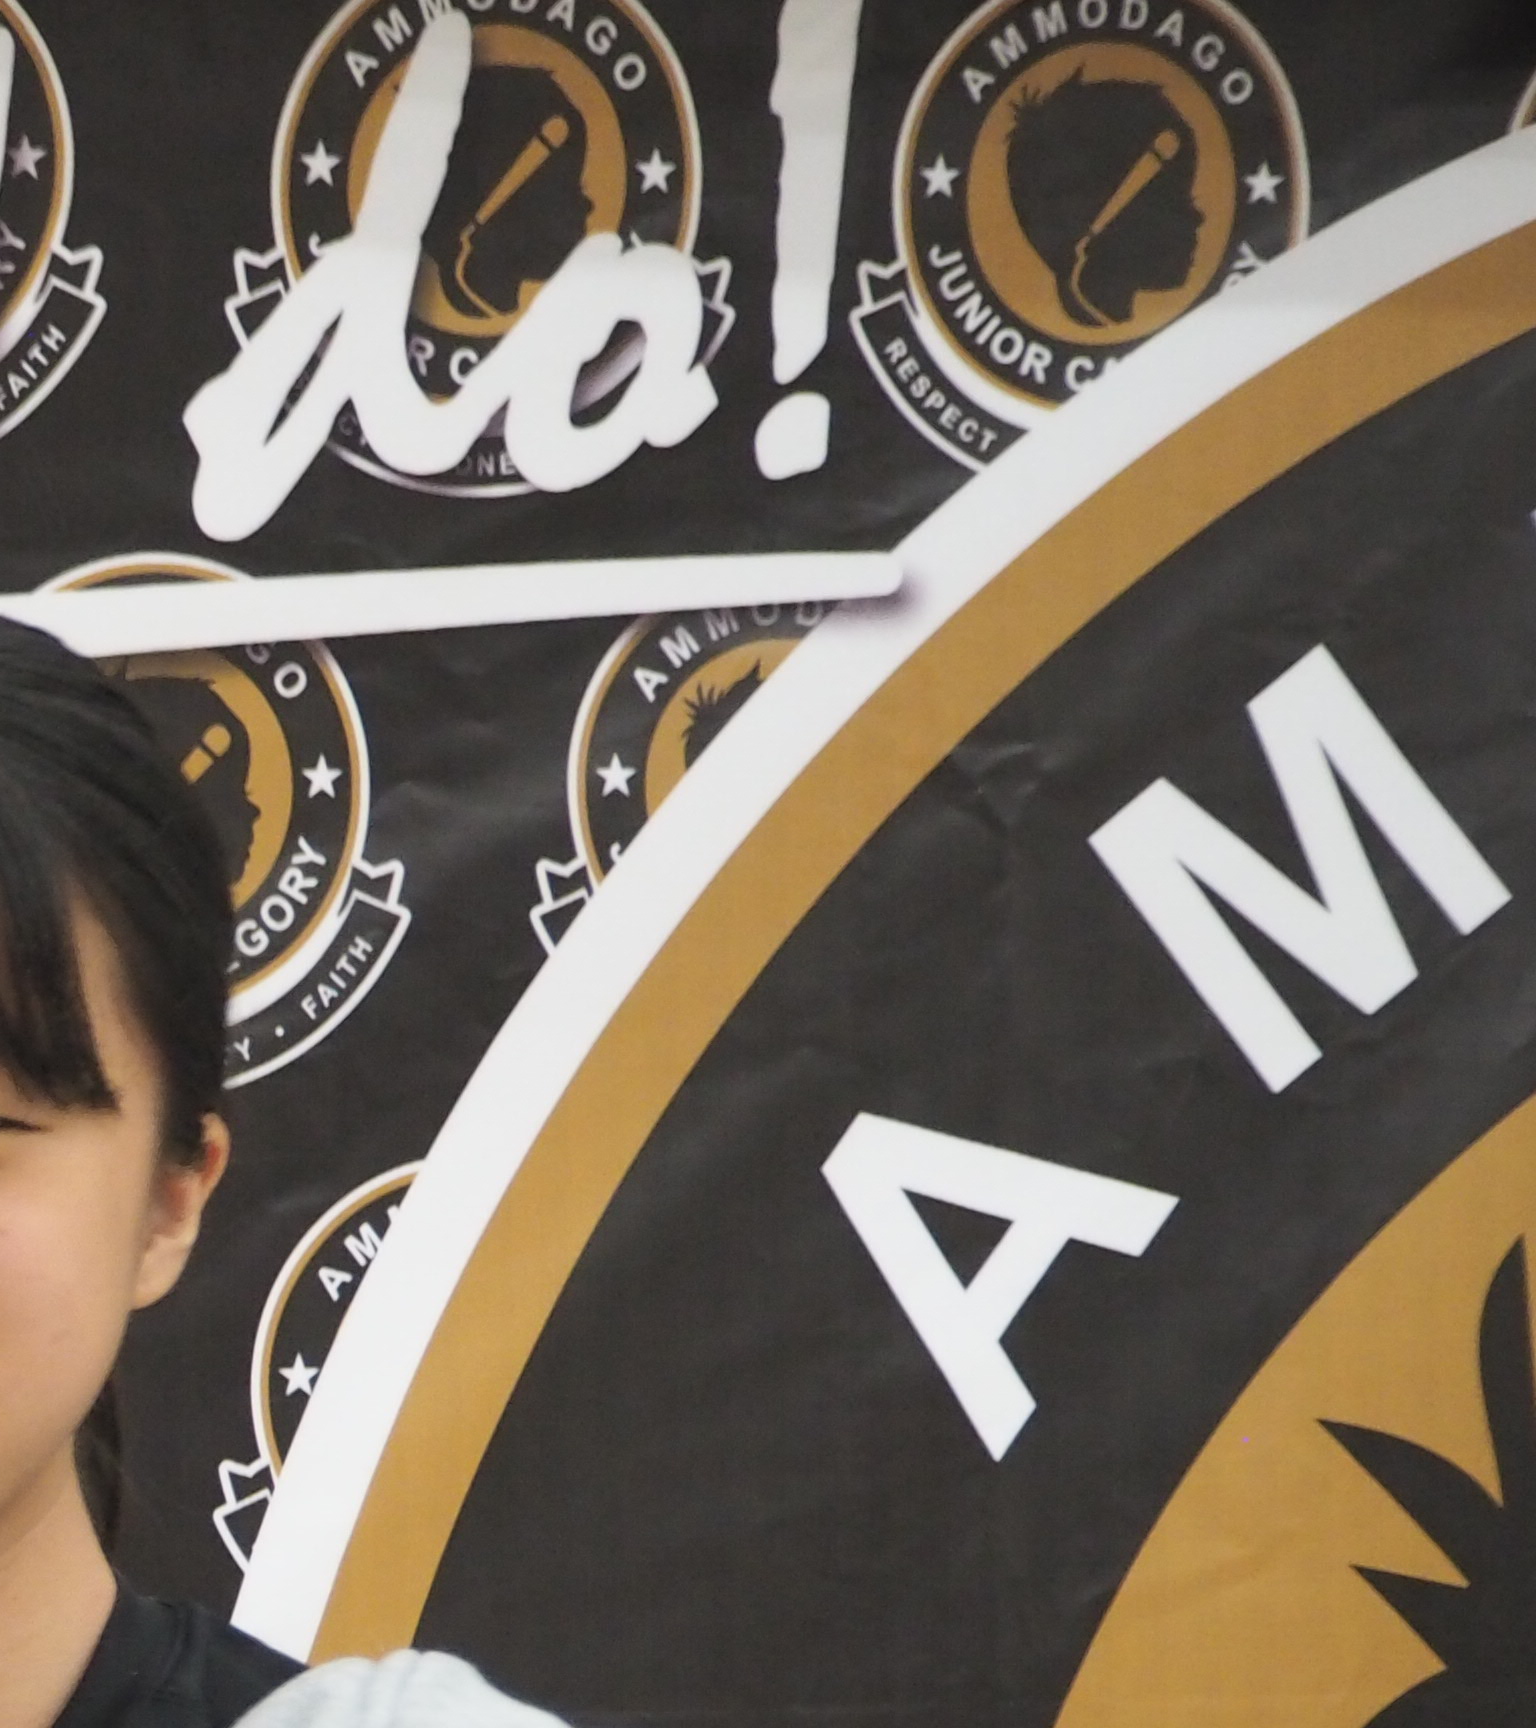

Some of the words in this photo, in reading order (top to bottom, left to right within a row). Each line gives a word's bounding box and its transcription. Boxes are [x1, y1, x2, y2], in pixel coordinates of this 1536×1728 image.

[960, 0, 1254, 104] AMMODAGO
[929, 243, 1053, 385] JUNIOR
[883, 336, 998, 455] RESPECT
[300, 935, 374, 1020] FAITH
